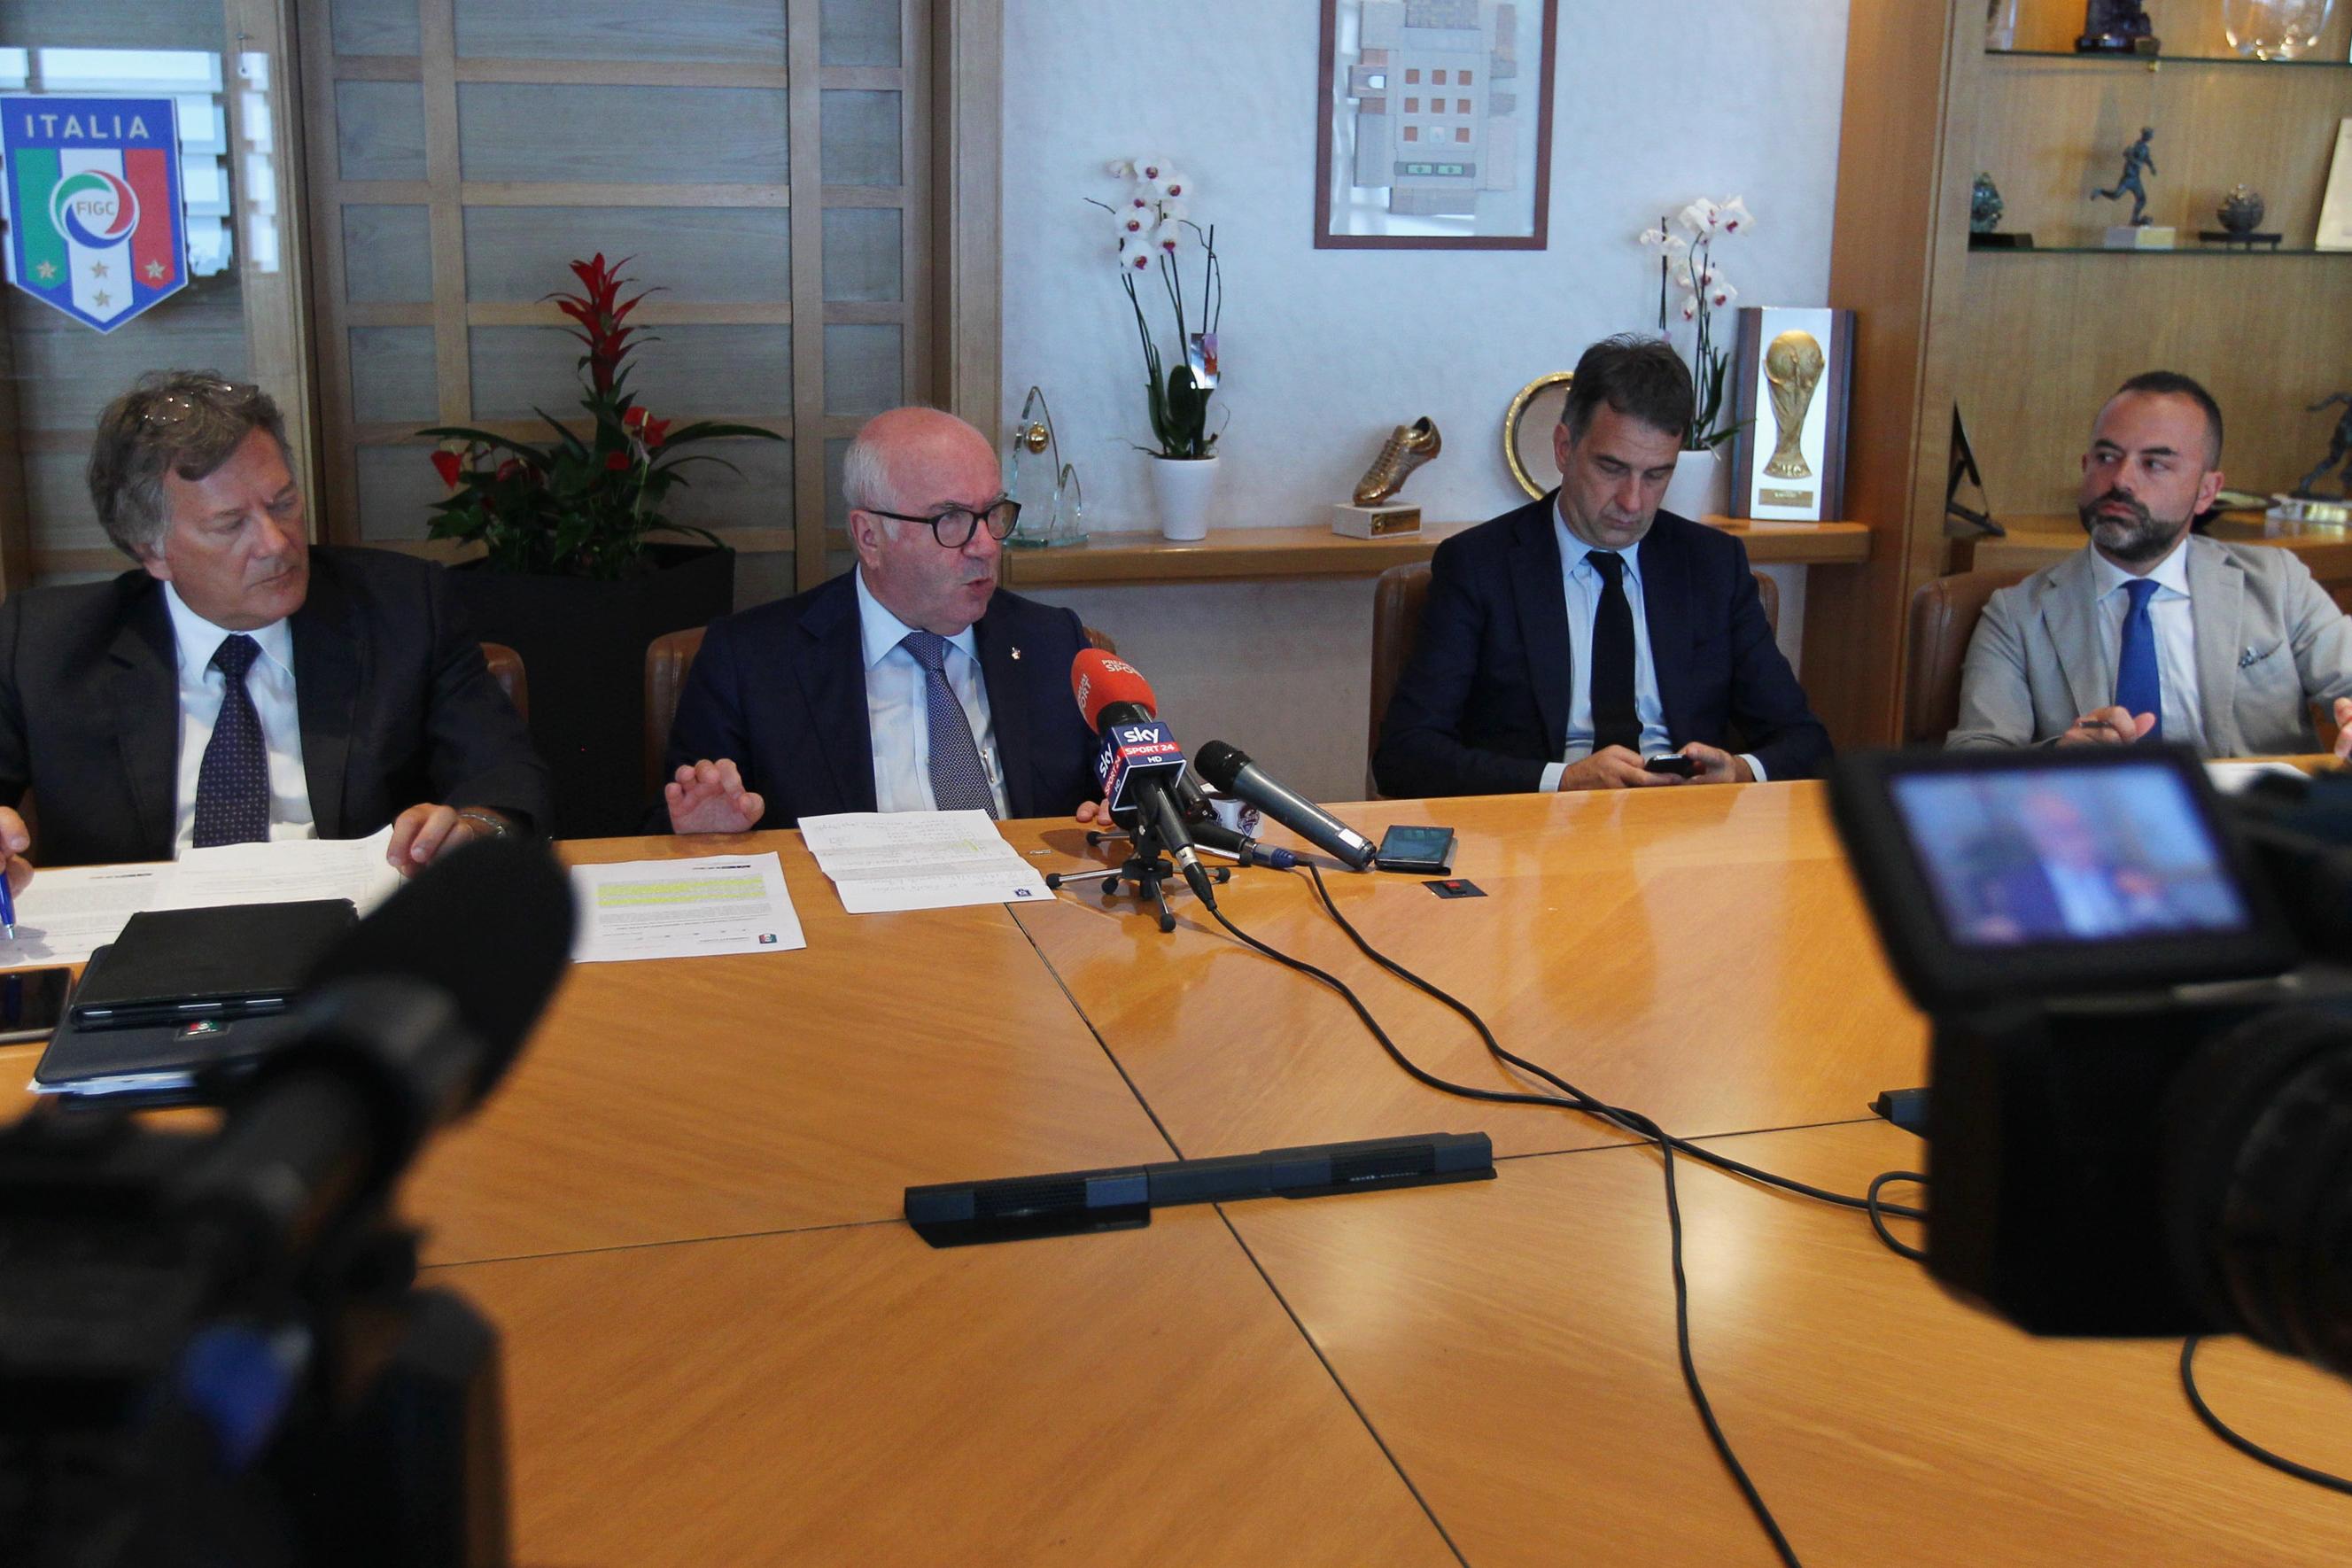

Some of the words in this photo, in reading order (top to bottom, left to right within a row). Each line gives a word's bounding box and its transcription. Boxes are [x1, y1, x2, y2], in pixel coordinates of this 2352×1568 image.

[26, 114, 150, 138] ITALIA
[76, 201, 115, 216] FIGC
[1123, 726, 1160, 743] sky
[1125, 745, 1160, 755] SPORT
[1099, 742, 1114, 779] sky
